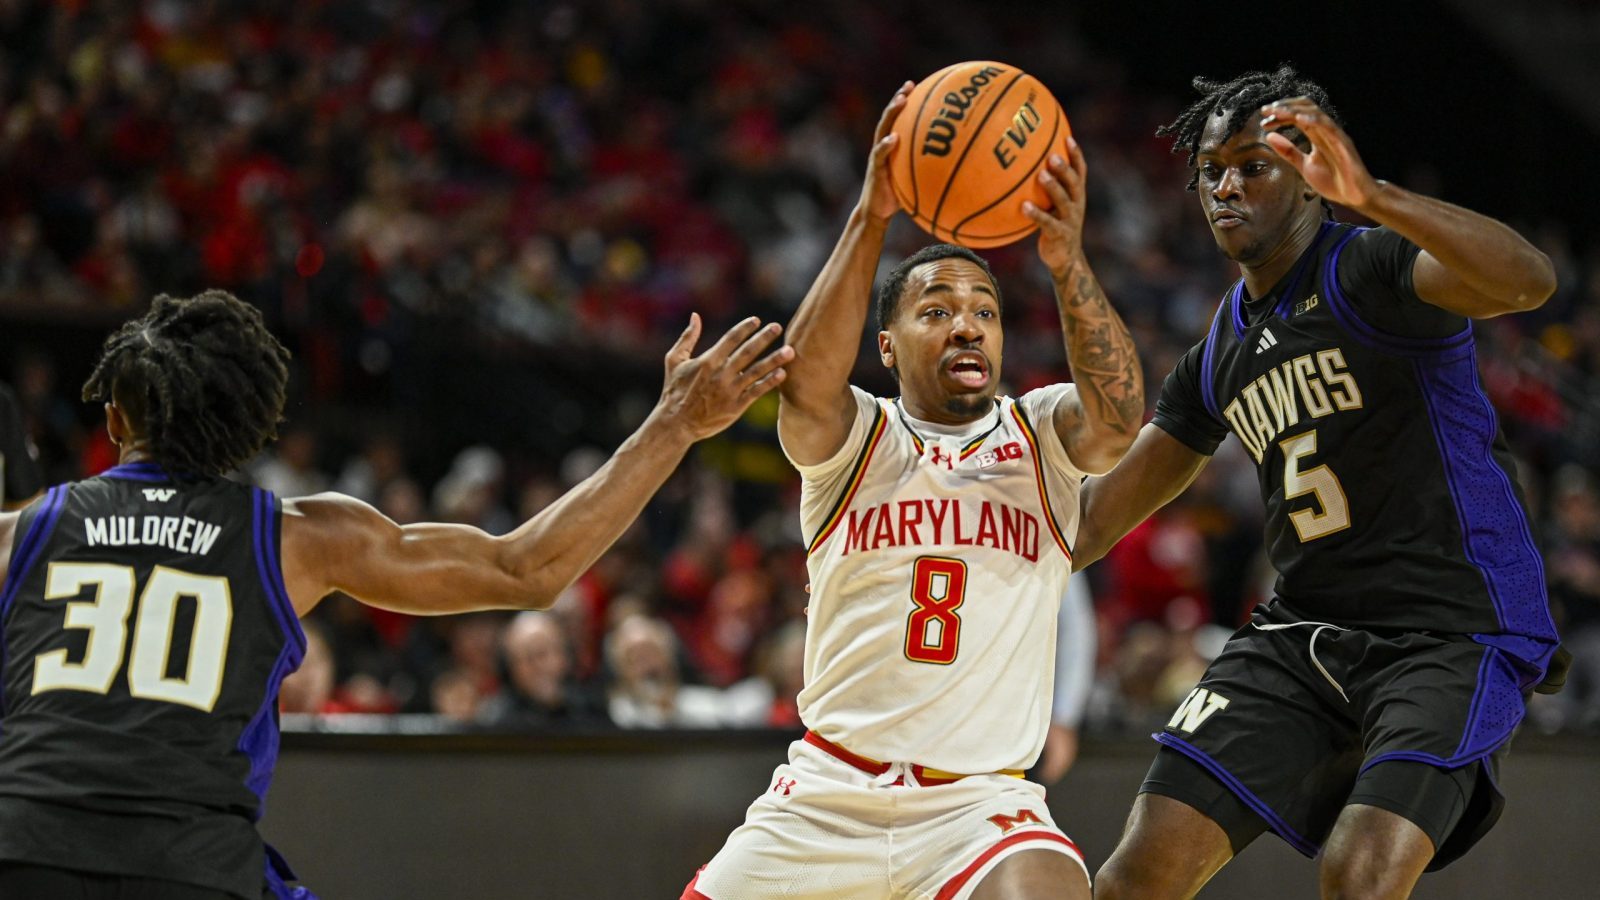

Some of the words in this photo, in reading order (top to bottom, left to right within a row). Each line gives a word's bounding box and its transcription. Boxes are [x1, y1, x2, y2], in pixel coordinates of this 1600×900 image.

[922, 66, 1006, 158] Wilson
[1223, 348, 1363, 465] DAWGS
[142, 488, 177, 502] W
[1279, 429, 1352, 543] 5
[84, 515, 222, 556] MULDREW
[842, 498, 1040, 563] MARYLAND
[30, 561, 234, 713] 30
[904, 555, 968, 666] 8
[1167, 687, 1231, 734] W
[986, 808, 1048, 835] M
